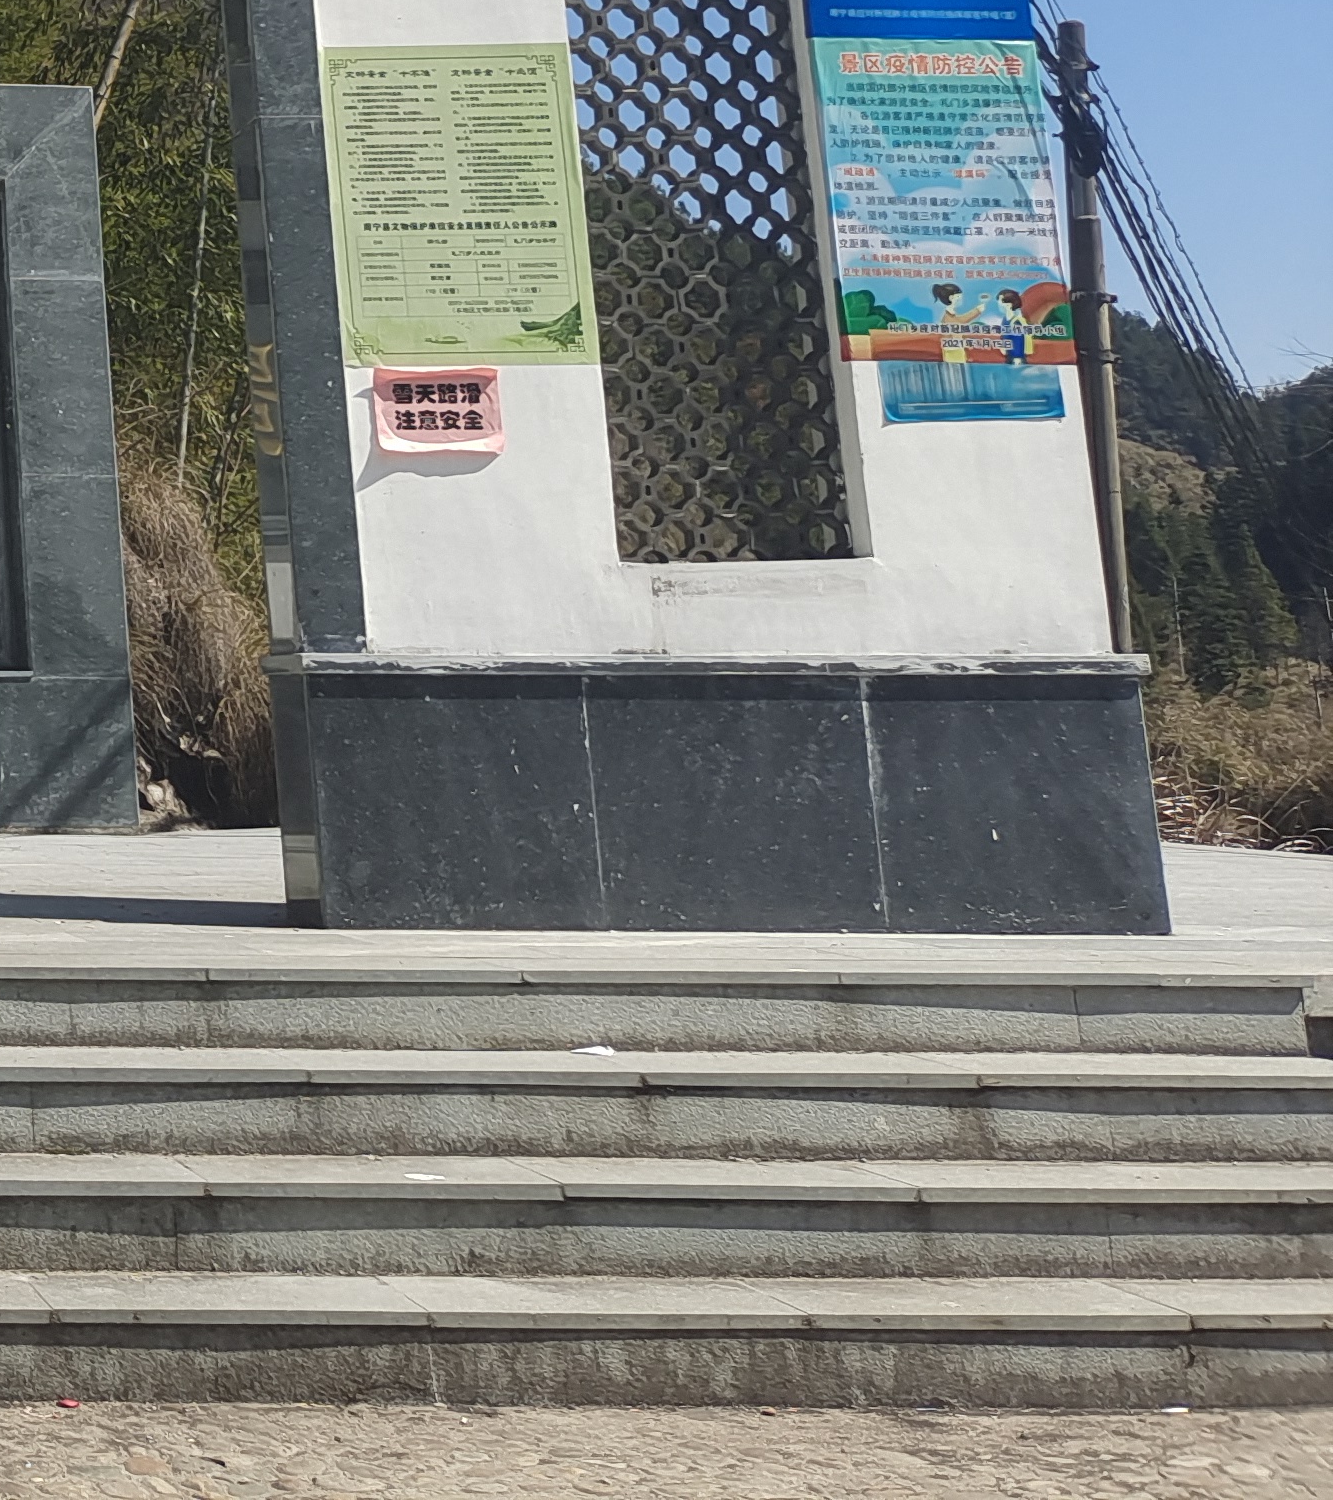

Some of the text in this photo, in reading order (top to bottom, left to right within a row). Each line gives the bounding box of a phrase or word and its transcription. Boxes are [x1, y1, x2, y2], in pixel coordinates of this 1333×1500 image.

[840, 53, 1026, 77] 景区疫情防控公告
[392, 383, 482, 404] 雪天路滑
[395, 410, 484, 430] 注意安全
